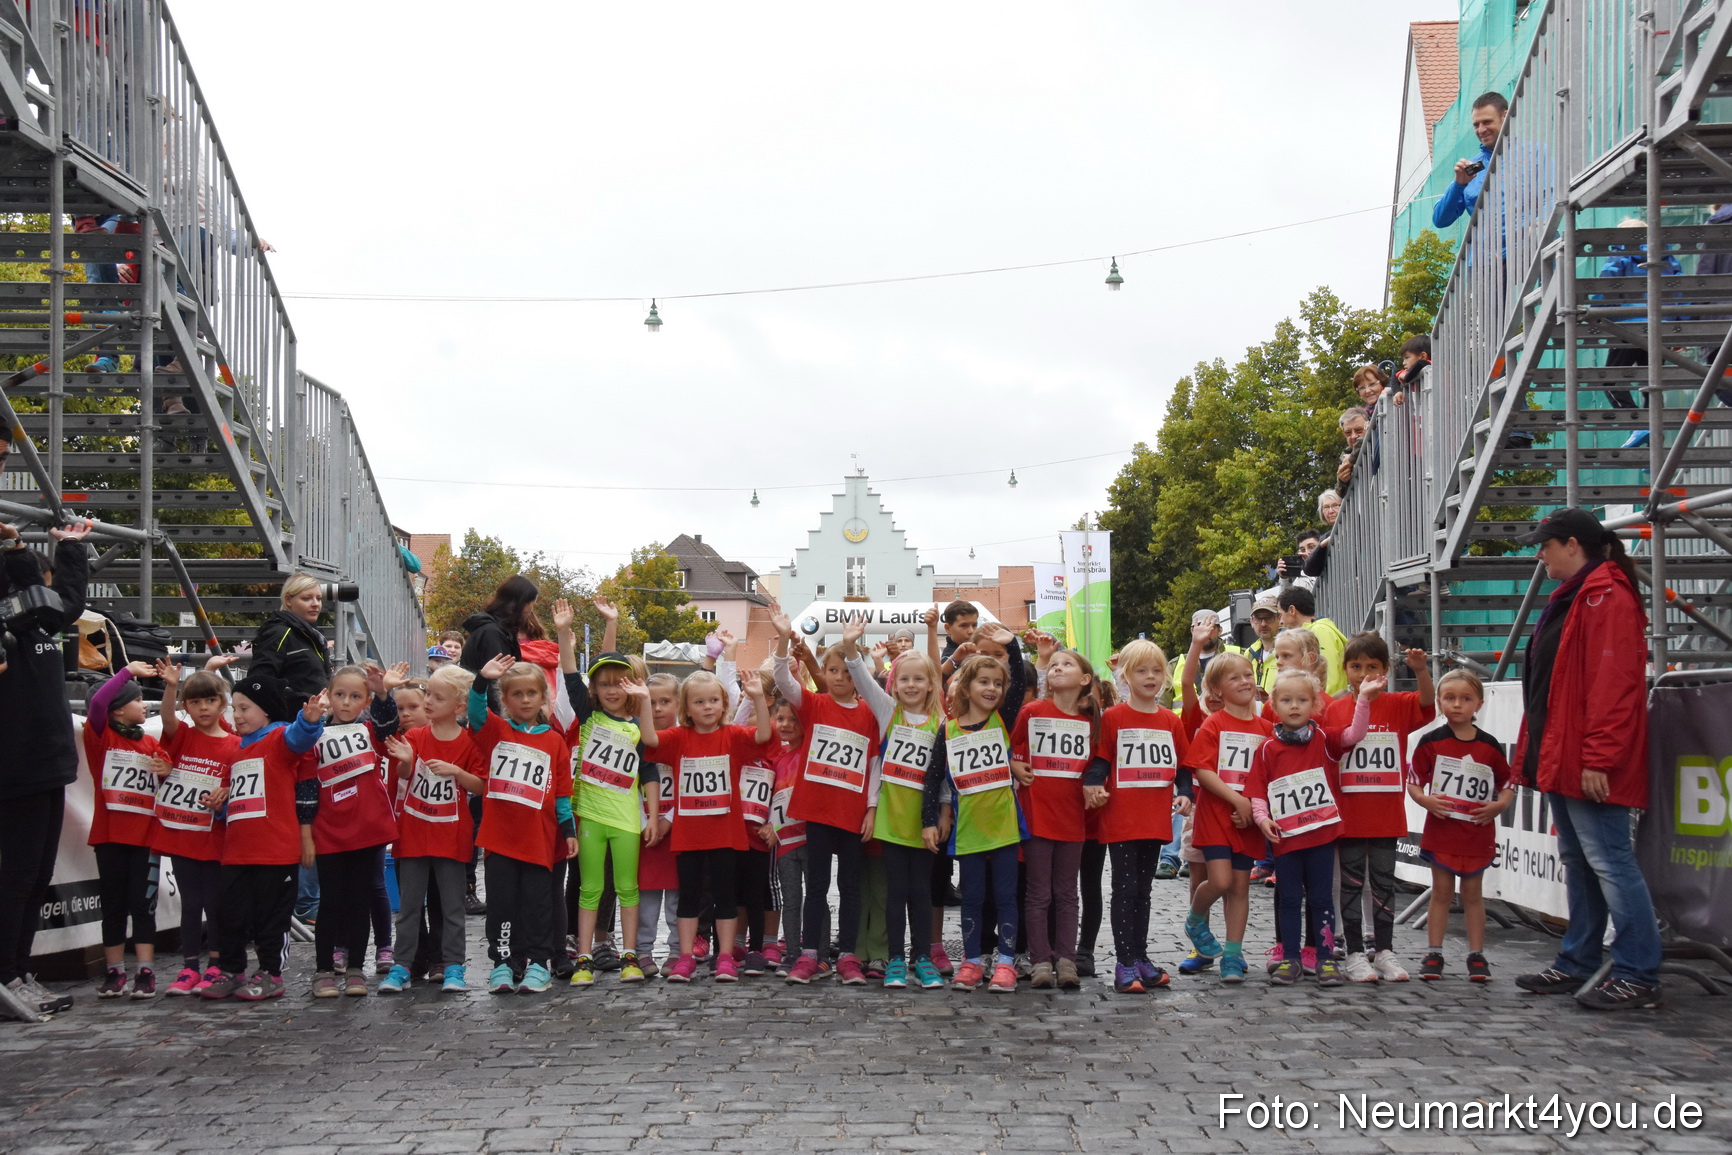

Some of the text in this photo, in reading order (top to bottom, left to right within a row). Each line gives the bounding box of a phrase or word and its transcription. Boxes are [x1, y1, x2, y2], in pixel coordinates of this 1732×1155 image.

[825, 609, 874, 623] BMW
[816, 738, 863, 769] 7237
[1035, 731, 1085, 757] 7168
[181, 754, 221, 768] Neumarkter
[588, 739, 636, 773] 7410
[954, 743, 1005, 773] 7232
[1122, 743, 1173, 765] 7109
[1345, 747, 1396, 770] 7040
[178, 763, 210, 775] Stadtlauf
[332, 758, 361, 774] Sophia
[495, 755, 544, 786] 7118
[823, 767, 847, 780] Anouk
[1046, 759, 1070, 769] Helga
[111, 765, 155, 793] 7254
[684, 770, 727, 794] 7031
[957, 776, 982, 787] Emma
[1137, 770, 1161, 779] Laura
[1356, 774, 1382, 783] Marie
[413, 773, 453, 801] 7045
[504, 783, 524, 795] Finia
[1440, 770, 1490, 801] 7139
[119, 793, 144, 806] Sophia
[695, 799, 717, 808] Paula
[1274, 782, 1330, 815] 7122
[71, 896, 83, 913] die
[497, 921, 511, 960] didas
